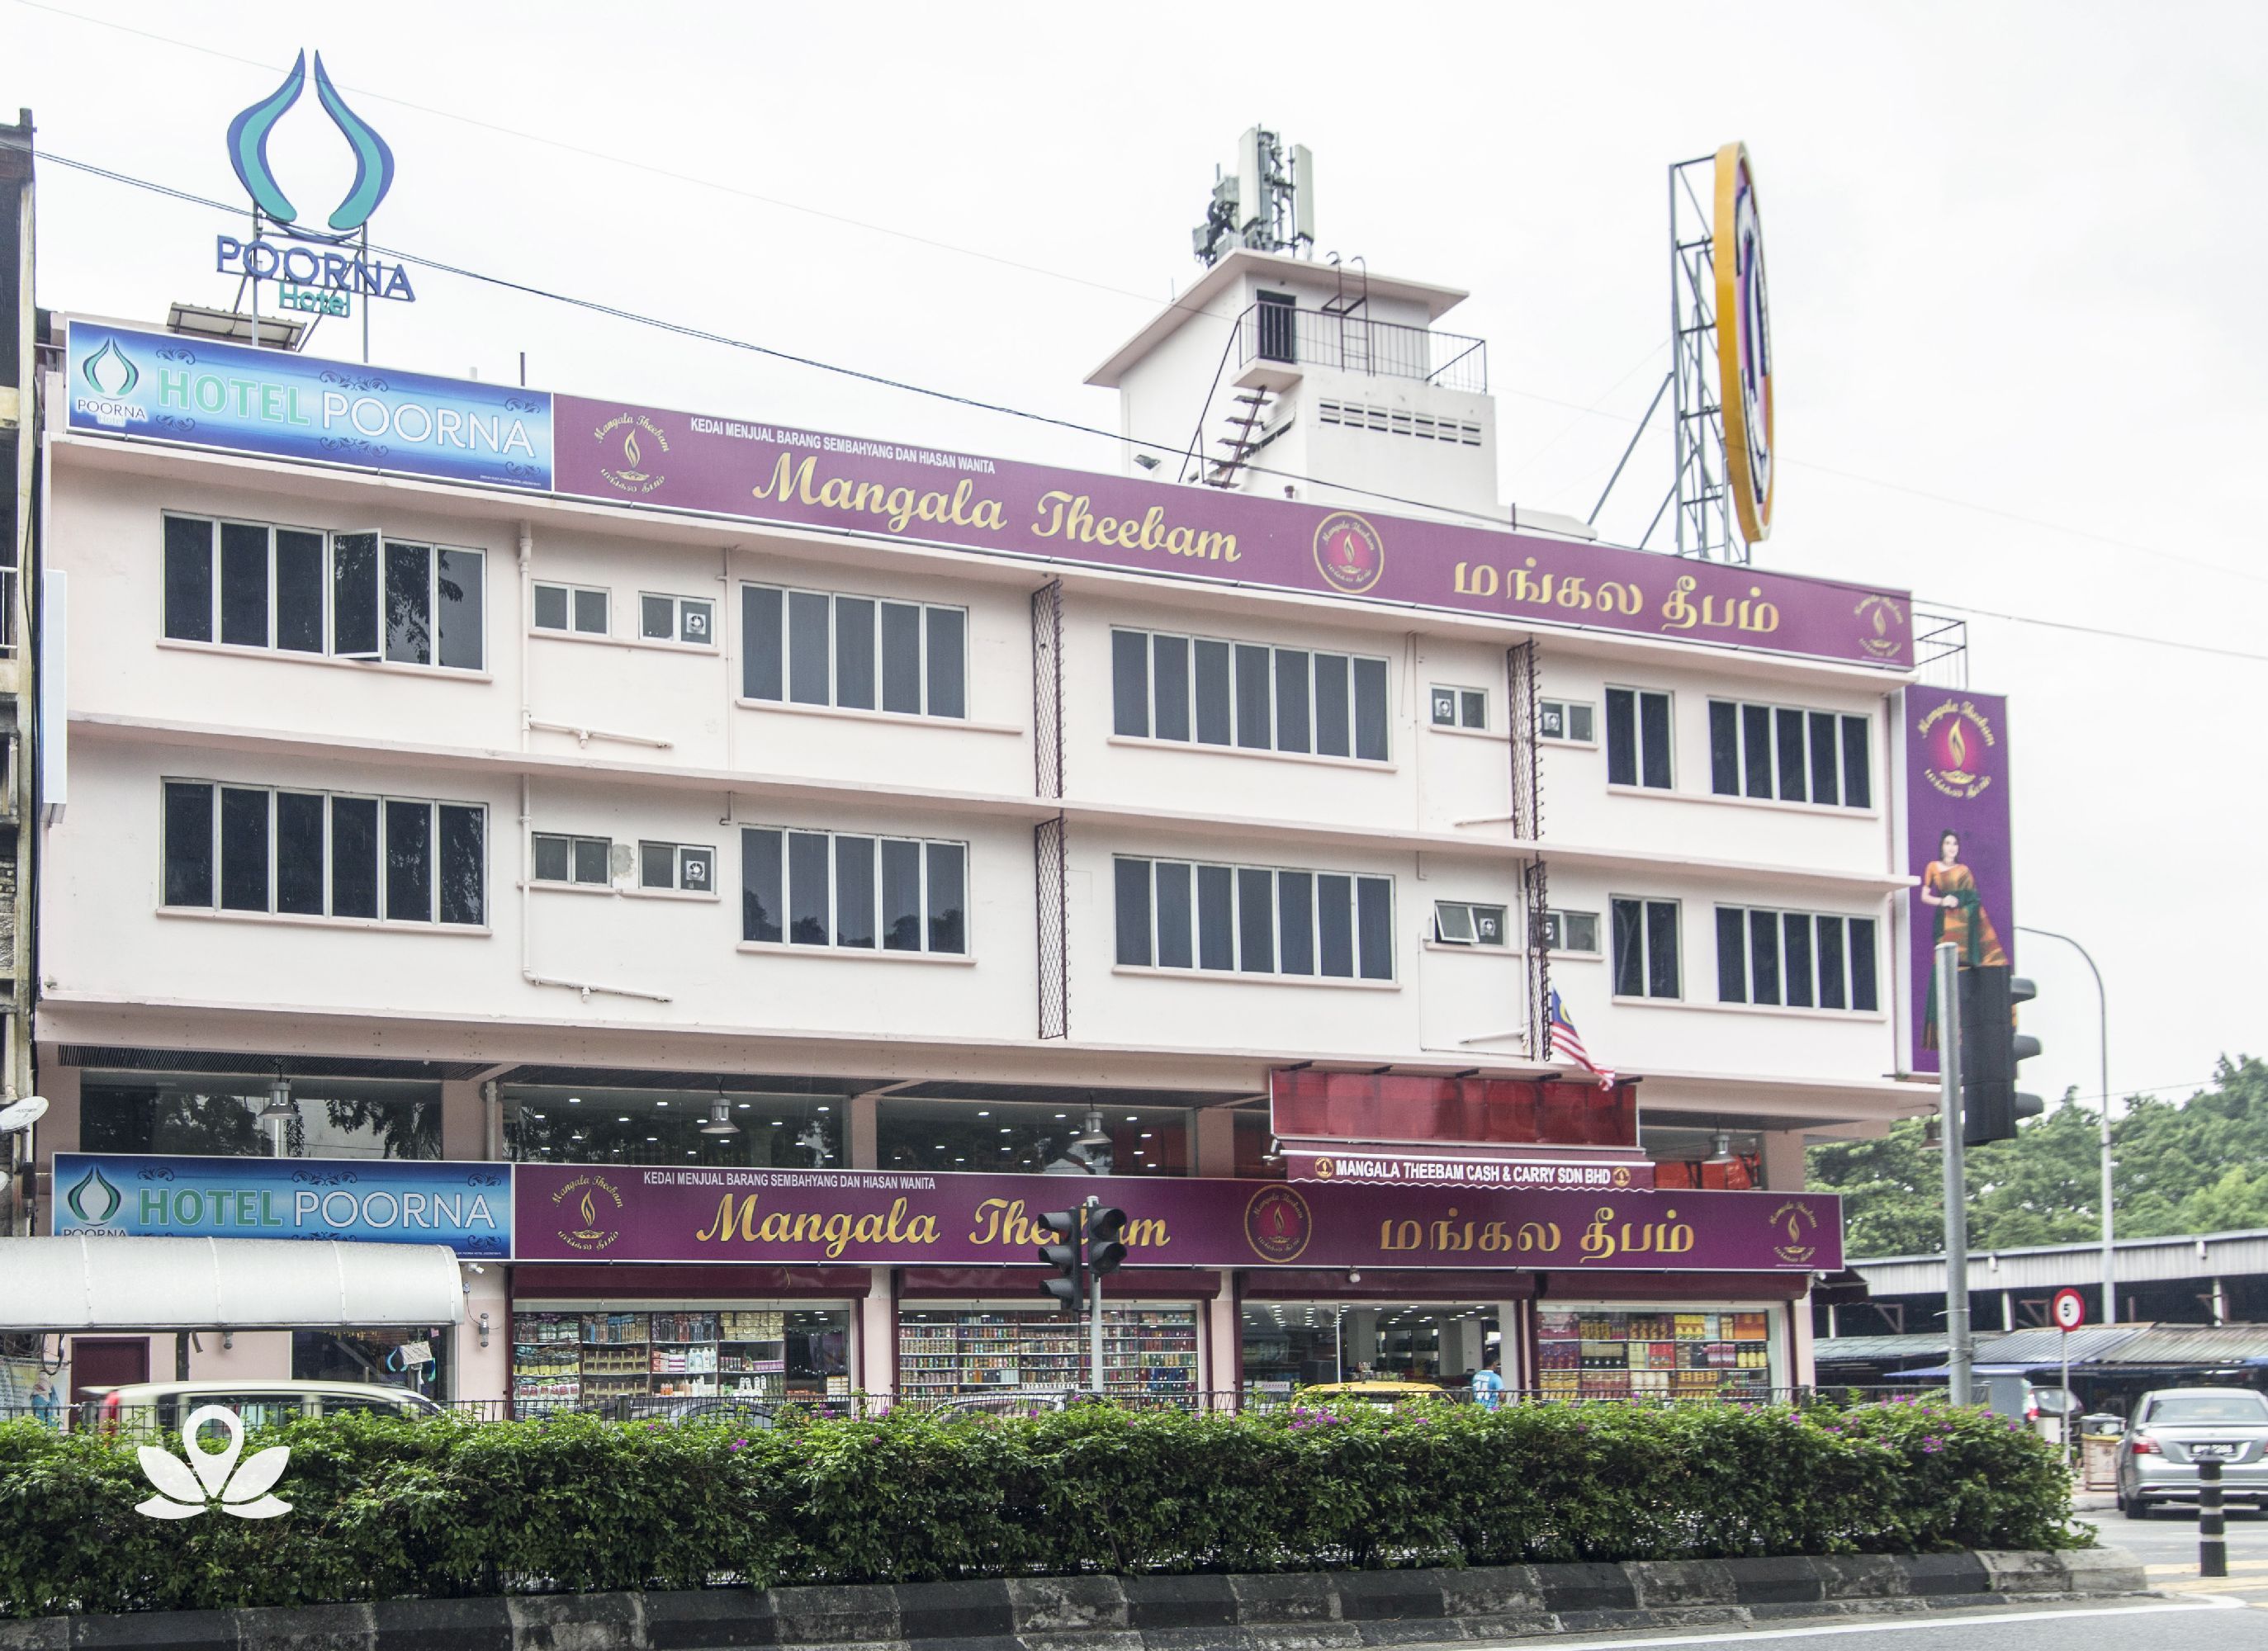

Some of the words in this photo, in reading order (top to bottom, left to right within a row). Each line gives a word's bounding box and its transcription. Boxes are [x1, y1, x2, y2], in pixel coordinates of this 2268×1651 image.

[217, 234, 416, 302] POORNA
[279, 281, 350, 318] Hotel
[78, 400, 146, 419] POORNA
[159, 368, 310, 426] HOTEL
[323, 390, 537, 457] POORNA
[594, 413, 633, 444] Mangala
[637, 415, 670, 452] Theebam
[691, 417, 723, 435] KEDAI
[726, 423, 774, 442] MENJUAL
[777, 430, 821, 449] BARANG
[824, 437, 893, 460] SEMBAHYANG
[896, 447, 917, 462] DAN
[919, 451, 956, 468] HIASAN
[958, 456, 995, 475] WANITA
[752, 452, 1007, 532] Mangala
[1031, 490, 1242, 563] Theebam
[1453, 557, 1643, 615] மங்கல
[1661, 575, 1779, 633] தீபம்
[552, 1175, 589, 1208] Mangala
[592, 1176, 623, 1209] Theebam
[644, 1171, 675, 1185] KEDAI
[677, 1172, 725, 1185] MENJUAL
[727, 1173, 769, 1186] BARANG
[770, 1174, 838, 1187] SEMBAHYANG
[840, 1175, 860, 1188] DAN
[863, 1176, 898, 1189] HIASAN
[900, 1176, 935, 1190] WANITA
[1336, 1160, 1400, 1178] MANGALA
[1404, 1162, 1464, 1180] THEEBAM
[1466, 1165, 1499, 1181] CASH
[1503, 1166, 1511, 1181] &
[1513, 1166, 1555, 1183] CARRY
[1557, 1168, 1584, 1184] SDN
[1585, 1169, 1611, 1185] BHD
[140, 1188, 283, 1227] HOTEL
[295, 1190, 497, 1229] POORNA
[696, 1193, 940, 1259] Mangala
[968, 1198, 1171, 1247] Them
[1380, 1207, 1561, 1252] மங்கல
[1579, 1206, 1694, 1265] தீபம்
[2063, 1303, 2071, 1317] 5
